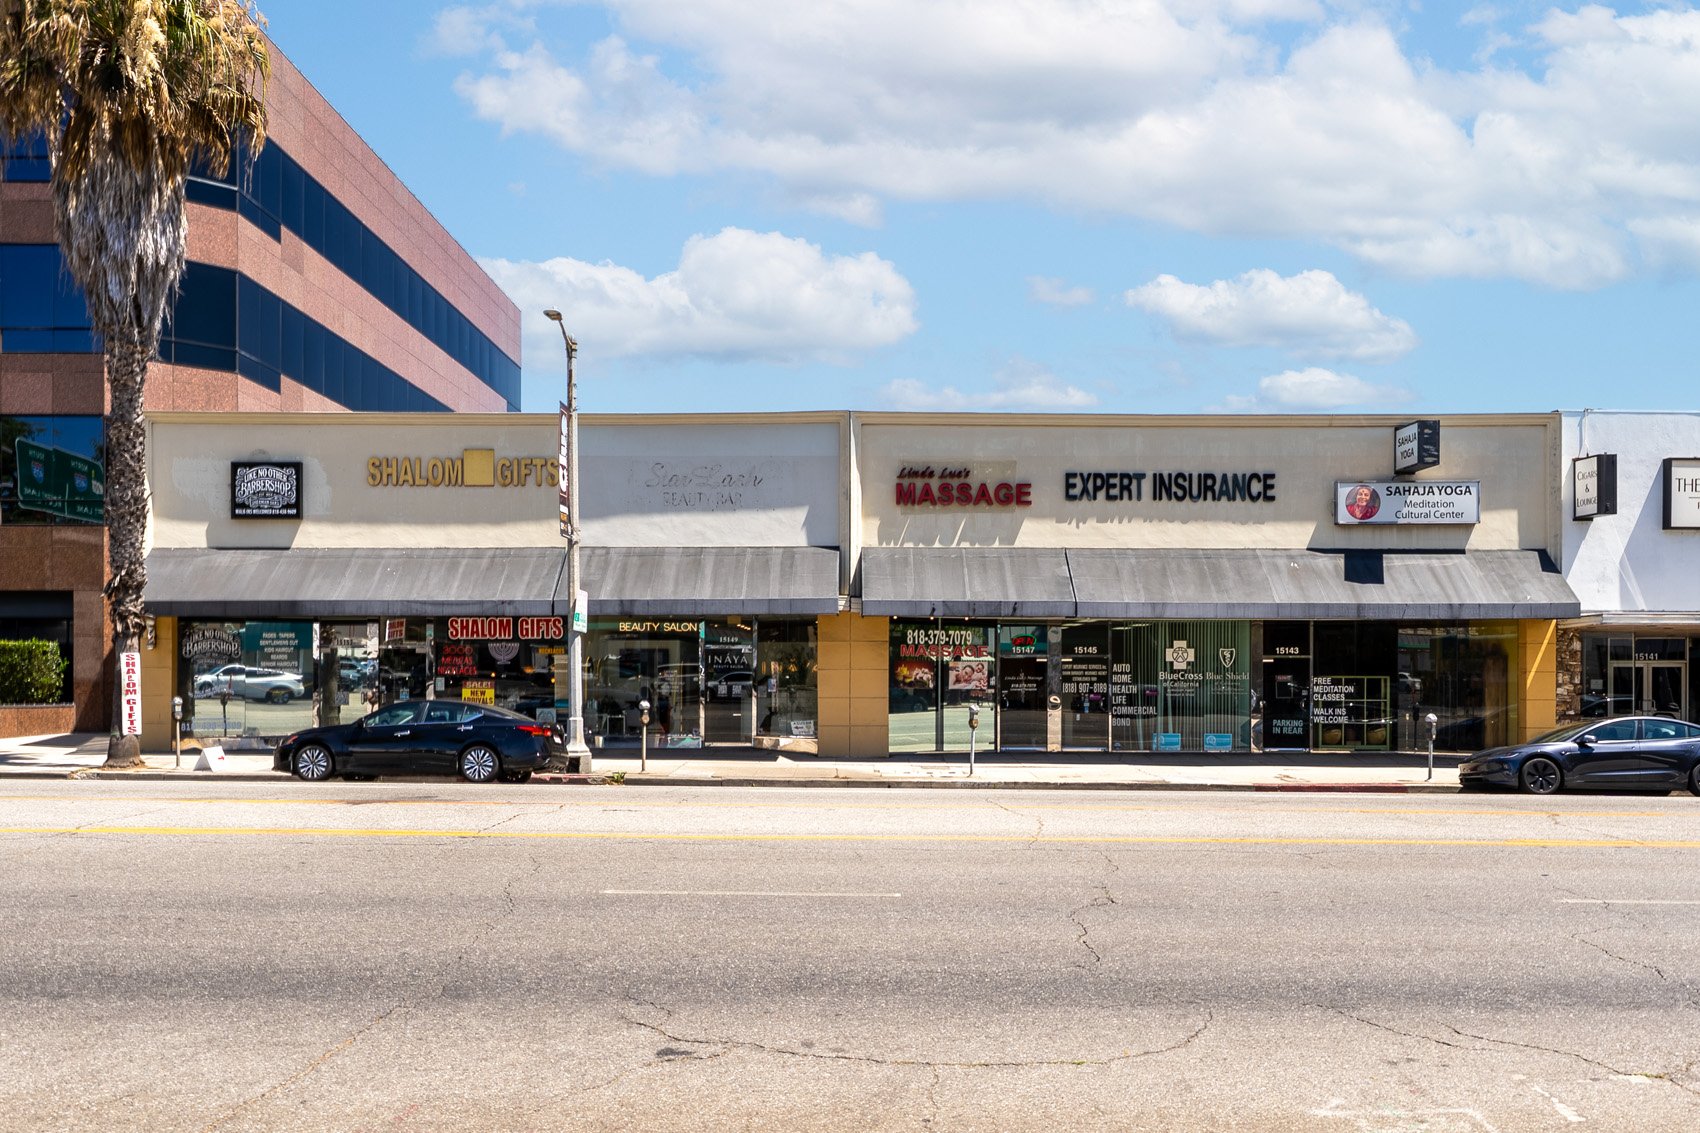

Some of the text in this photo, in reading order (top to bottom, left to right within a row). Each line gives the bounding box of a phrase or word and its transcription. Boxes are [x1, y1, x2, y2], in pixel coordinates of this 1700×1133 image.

[1397, 432, 1417, 448] SAHAJA
[1400, 447, 1415, 461] YOGA
[244, 468, 288, 482] LIKE NO OTHER
[367, 456, 561, 487] SHALOM GIFTS
[238, 479, 291, 498] BARBERSHOP
[1064, 472, 1276, 503] EXPERT INSURANCE
[1675, 477, 1700, 493] THE
[895, 482, 1032, 506] MASSAGE
[1404, 499, 1455, 509] Meditation
[1395, 510, 1464, 519] Cultural Center
[448, 617, 513, 640] SHALOM
[518, 617, 564, 640] GIFTS
[620, 622, 697, 632] BEAUTY SALON
[906, 629, 972, 645] 818-379-7079
[183, 639, 241, 658] BARBERSHOP
[900, 644, 989, 657] MASSAGE
[1012, 646, 1035, 654] 15147
[1074, 646, 1098, 654] 15145
[1112, 664, 1131, 673] AUTO
[1112, 674, 1132, 683] HOME
[1159, 671, 1203, 680] BlueCross
[1206, 671, 1249, 680] Blue Shield
[125, 654, 137, 734] SHALOM GIFTS
[1062, 682, 1108, 694] (818) 907-8189
[1112, 685, 1138, 694] HEALTH
[1112, 696, 1127, 704] LIFE
[1112, 706, 1158, 715] COMMERCIAL
[1112, 718, 1131, 726] BOND
